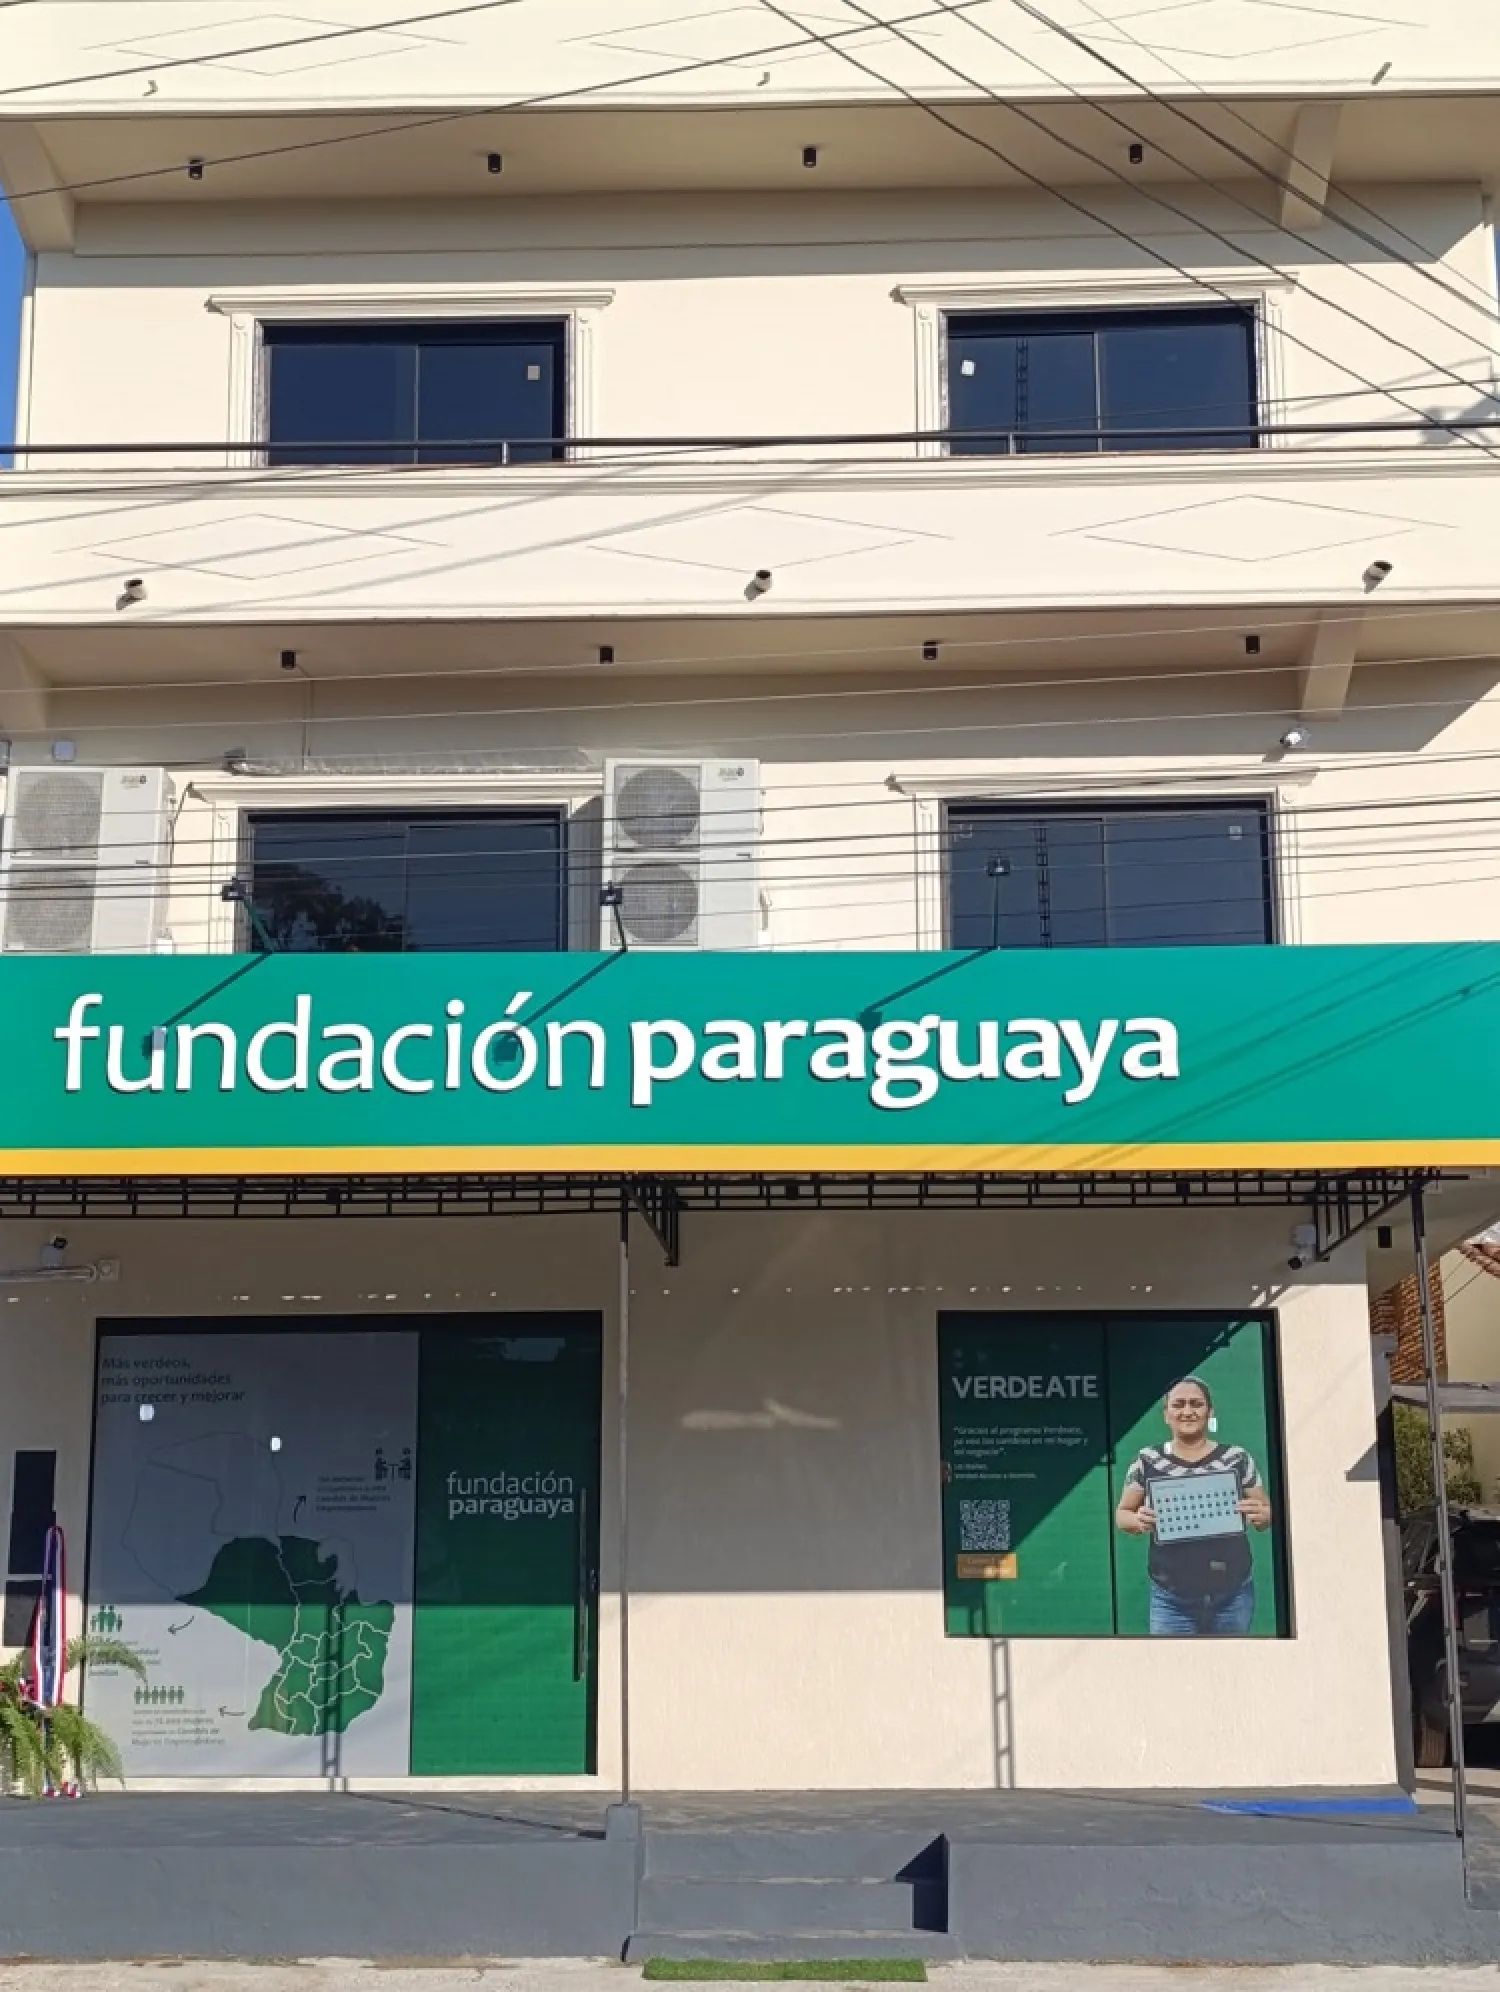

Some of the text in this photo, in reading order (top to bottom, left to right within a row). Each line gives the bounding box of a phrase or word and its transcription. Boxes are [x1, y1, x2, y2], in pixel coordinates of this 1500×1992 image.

[54, 991, 1180, 1109] fundación paraguaya
[101, 1371, 232, 1388] más oportunidades
[952, 1375, 1098, 1399] VERDEATE
[101, 1393, 131, 1405] para
[134, 1393, 176, 1403] crecer
[192, 1389, 246, 1404] mejorar
[446, 1470, 573, 1495] fundación
[448, 1496, 574, 1520] paraguaya
